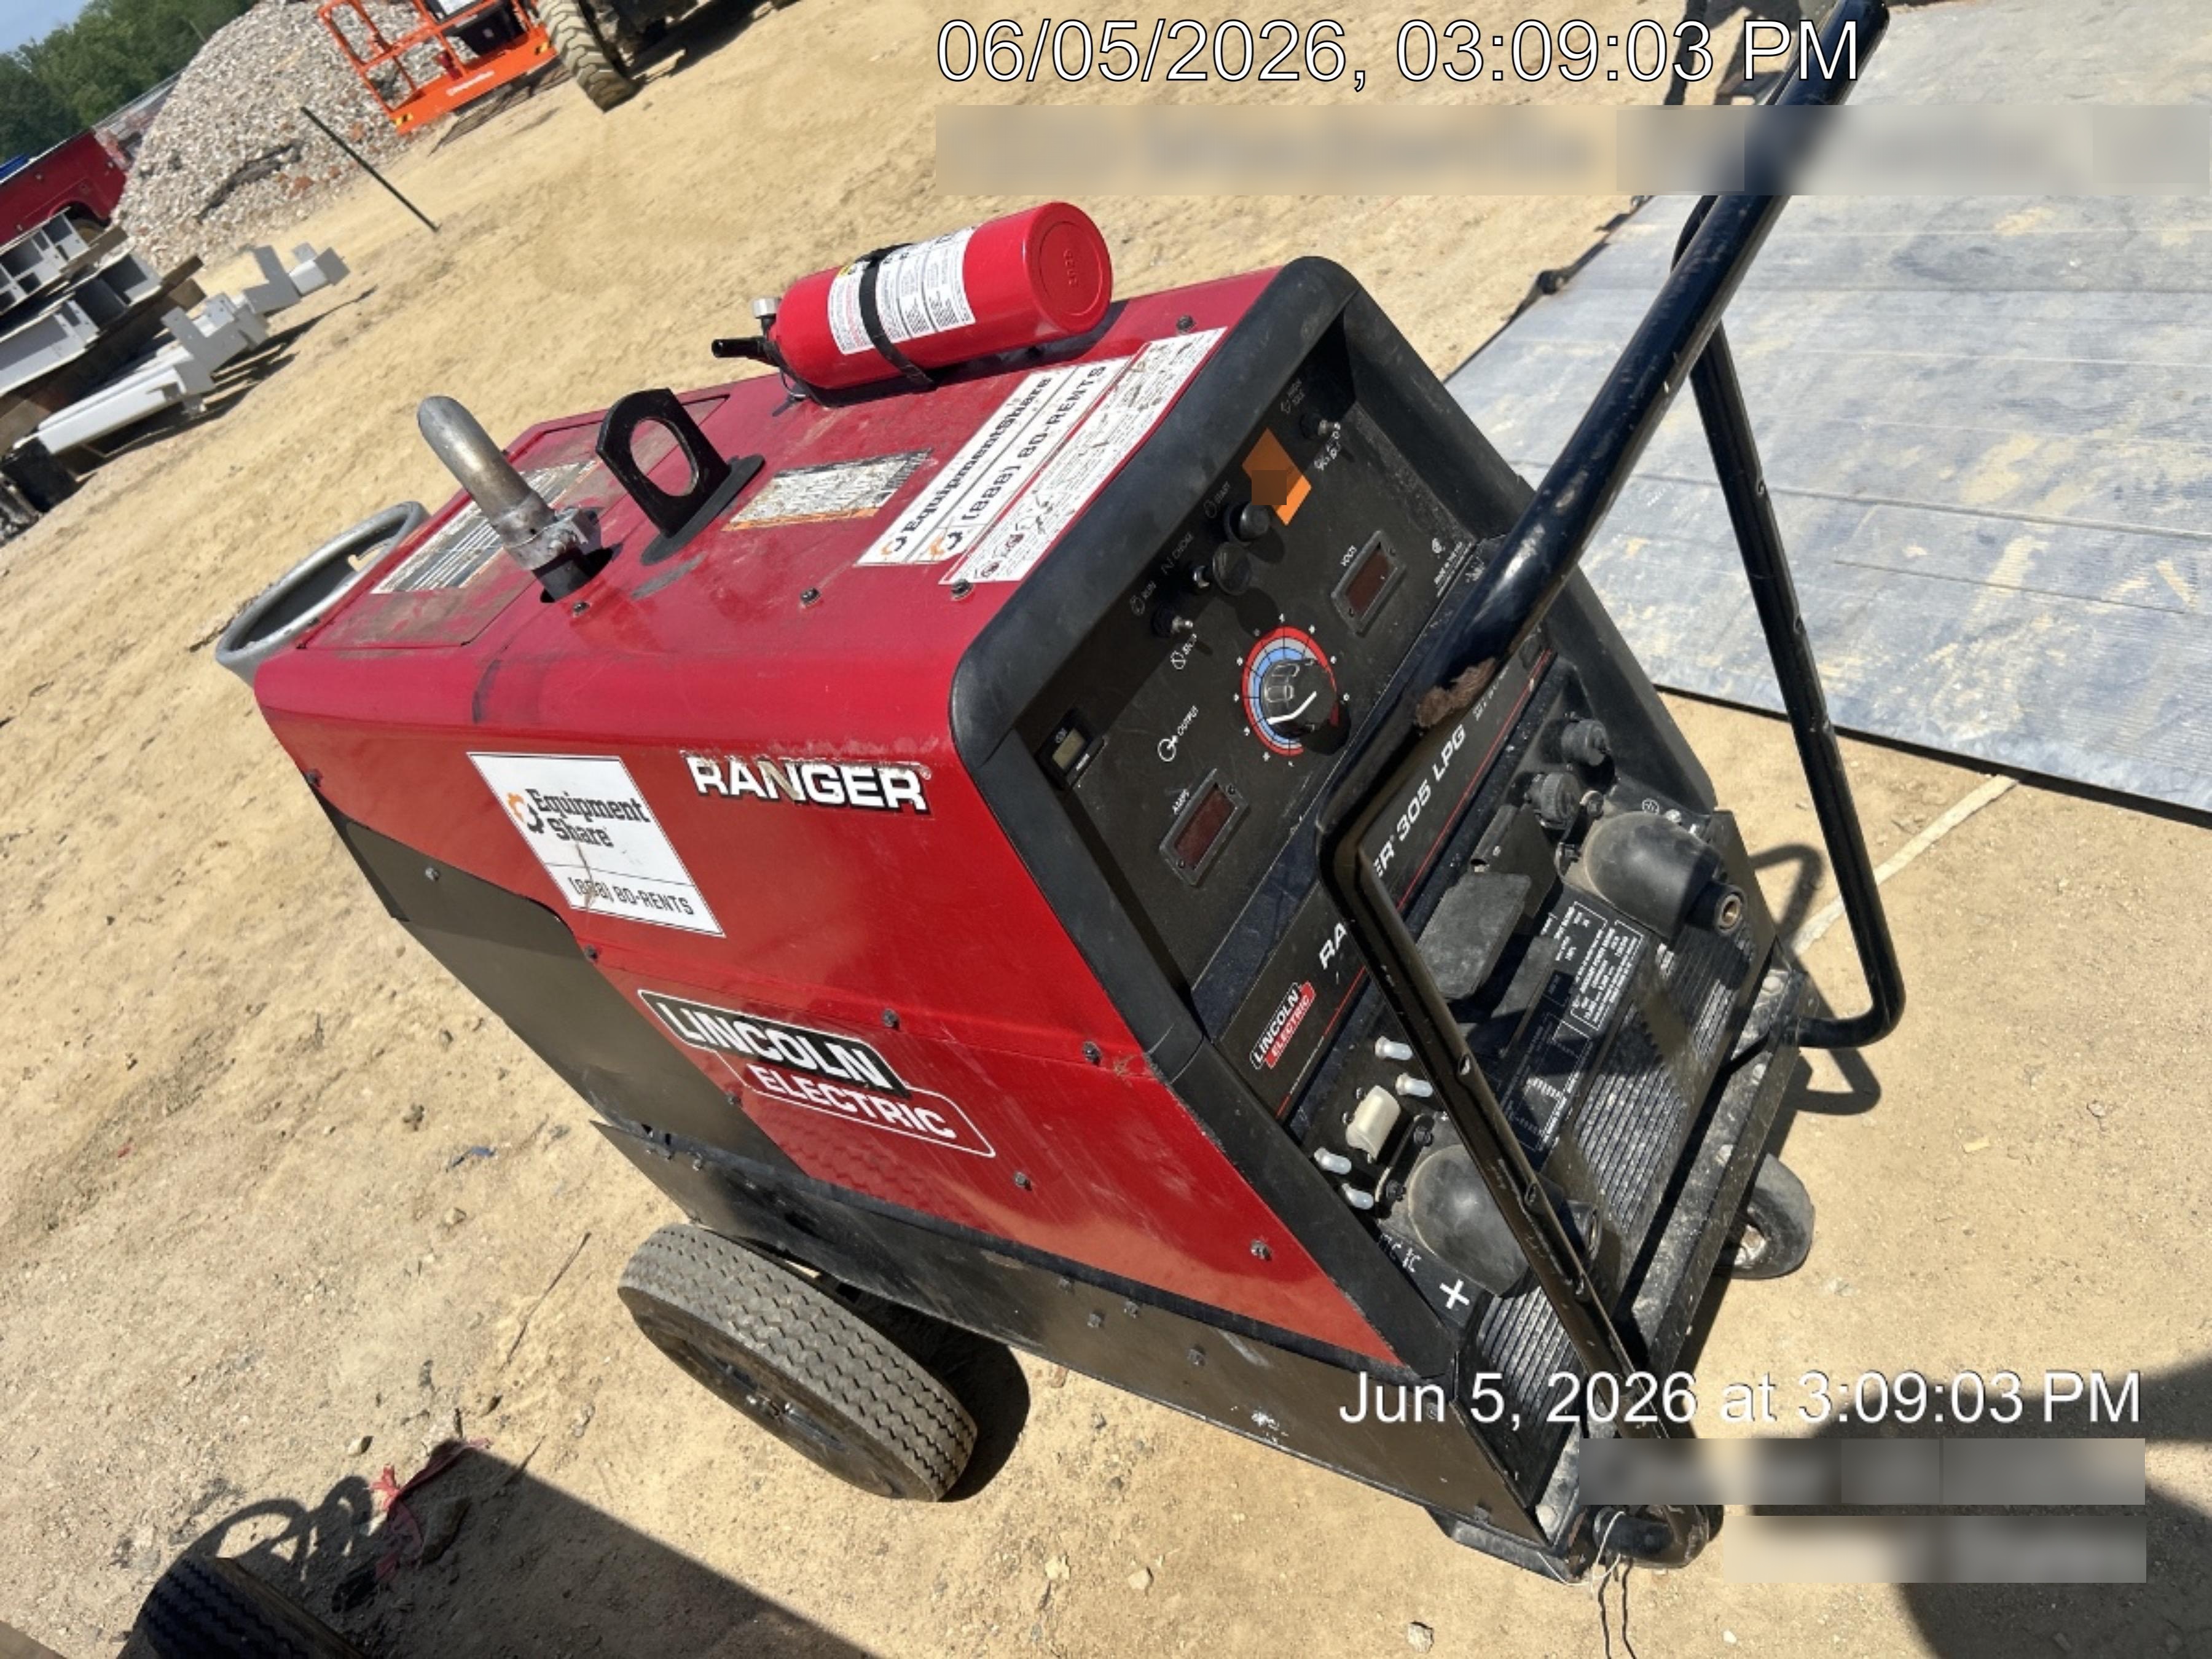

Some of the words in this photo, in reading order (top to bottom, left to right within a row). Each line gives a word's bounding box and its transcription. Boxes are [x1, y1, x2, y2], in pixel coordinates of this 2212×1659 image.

[902, 376, 1053, 532] EquipmentShare
[525, 788, 651, 822] Equipment
[1397, 779, 1431, 841] 305
[1432, 724, 1465, 782] LPG
[547, 818, 614, 847] Share
[656, 1002, 893, 1089] LINCOLN
[1253, 989, 1299, 1062] LINCOLN
[1271, 995, 1309, 1056] ELECTRIC
[745, 1064, 957, 1139] ELECTRIC
